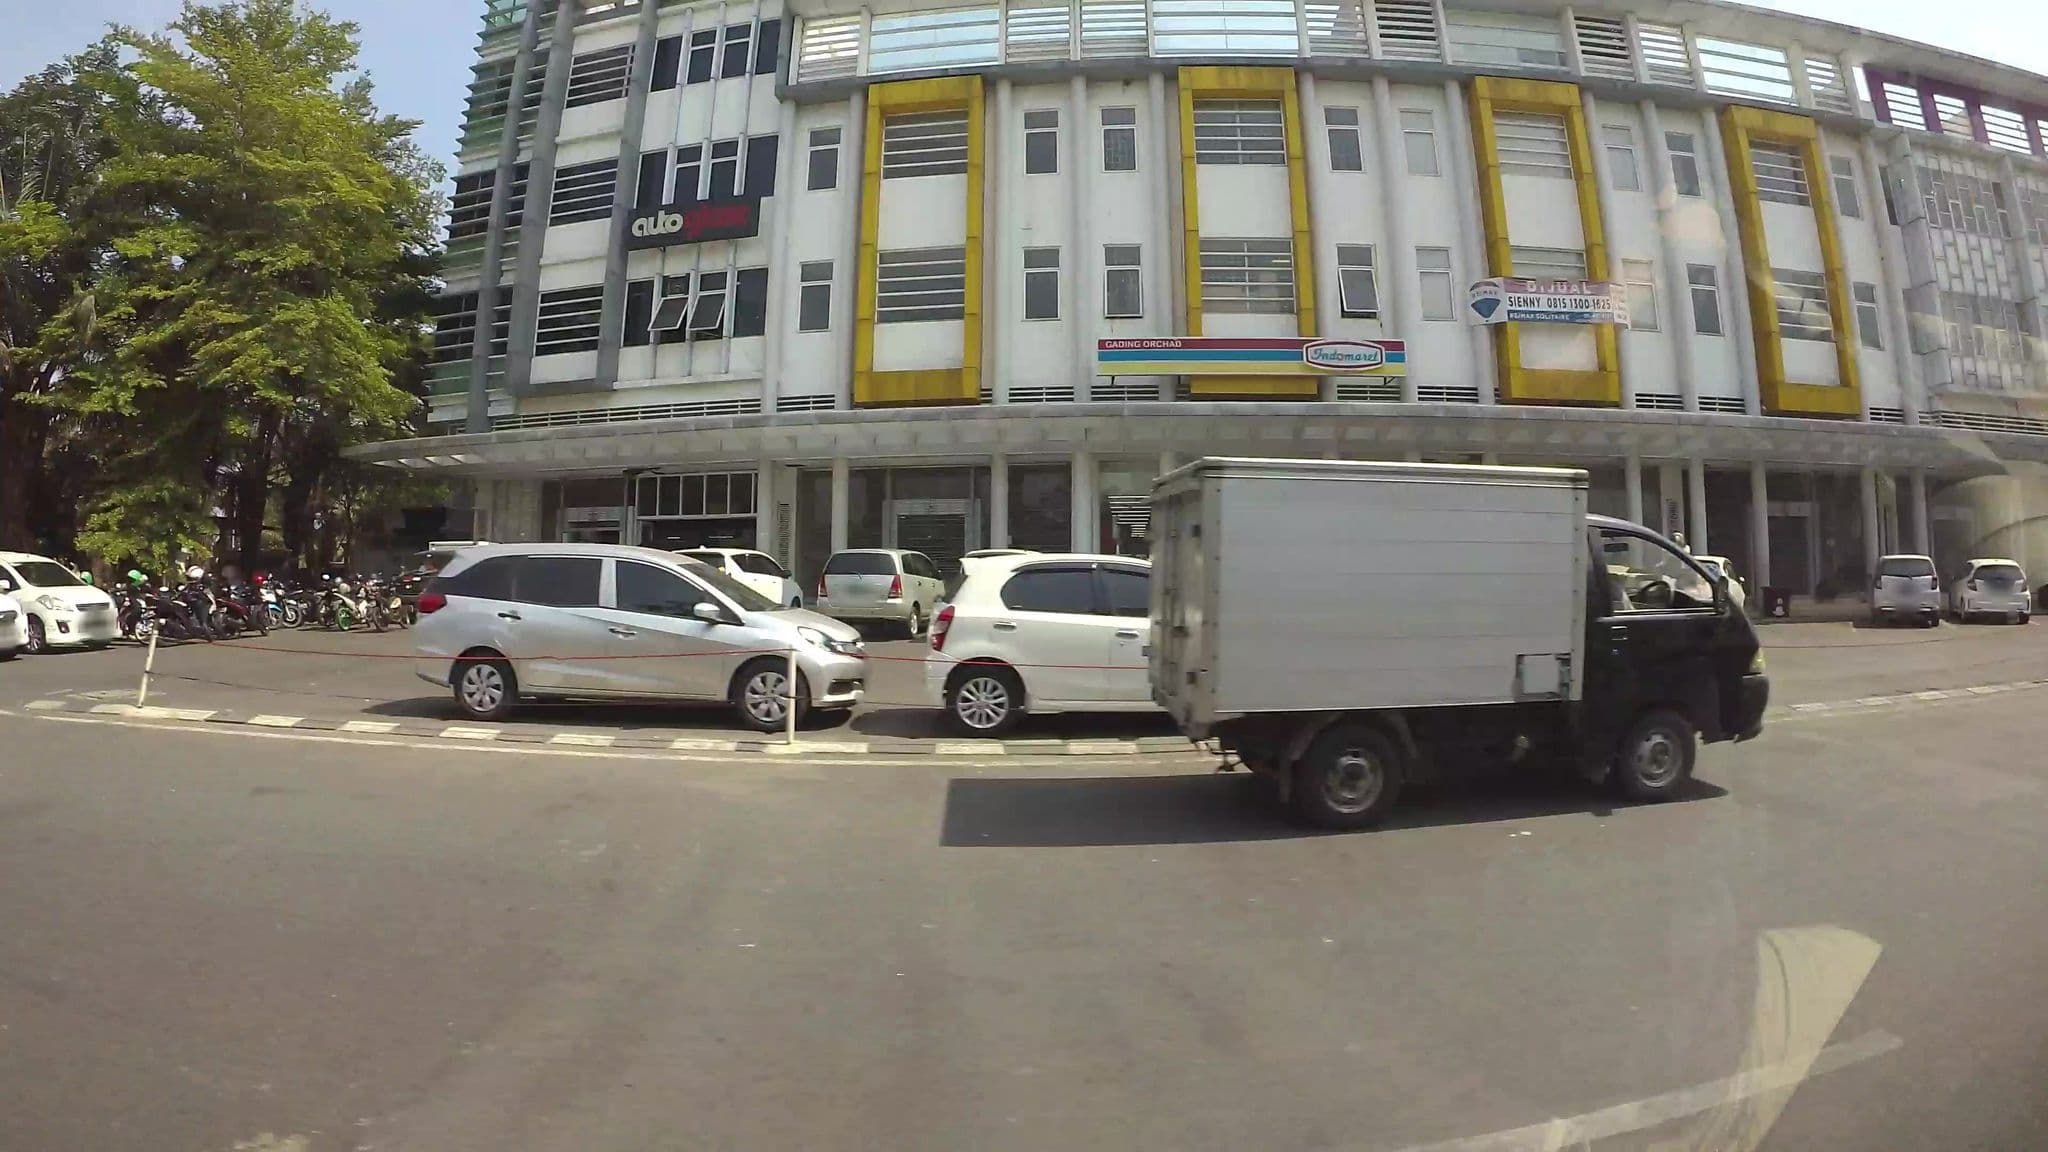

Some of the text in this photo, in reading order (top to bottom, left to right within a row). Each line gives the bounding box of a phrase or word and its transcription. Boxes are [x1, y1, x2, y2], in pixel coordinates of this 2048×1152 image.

[1508, 296, 1541, 308] SIENNY
[1547, 297, 1567, 309] 0815
[1569, 298, 1590, 310] 1300
[1105, 340, 1182, 348] GADING ORCHAD
[1311, 347, 1378, 361] Indomaret
